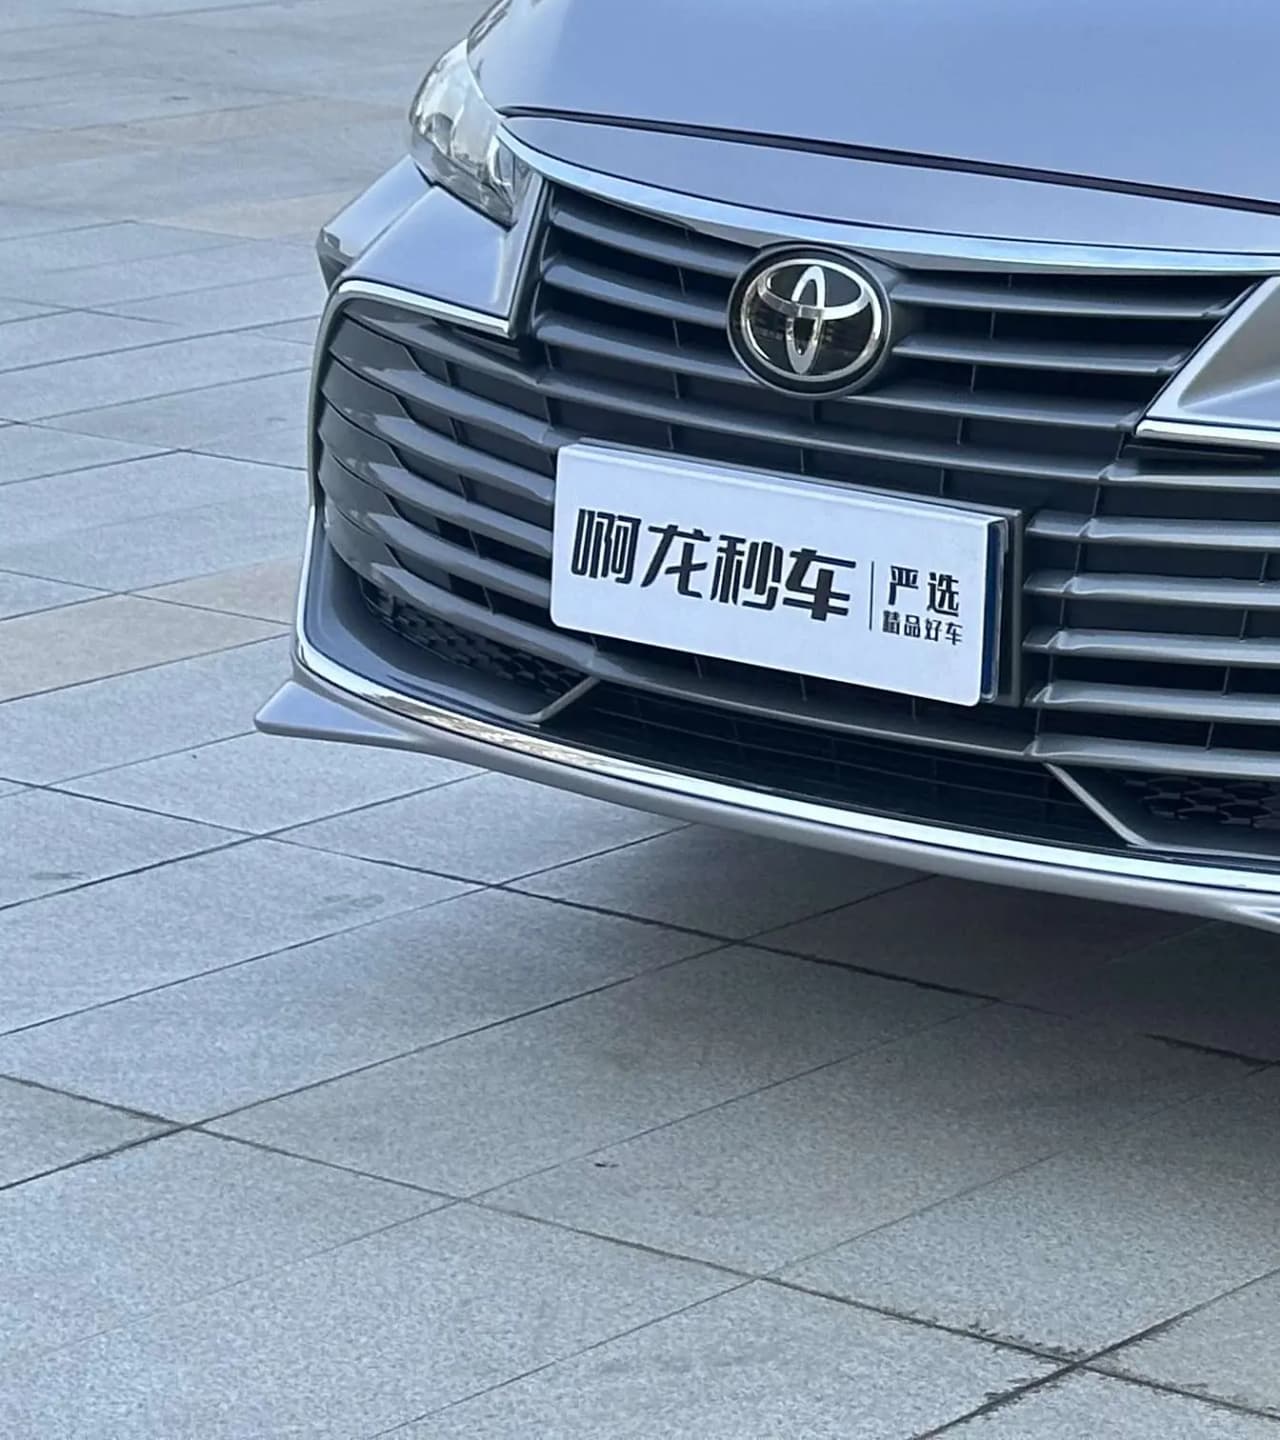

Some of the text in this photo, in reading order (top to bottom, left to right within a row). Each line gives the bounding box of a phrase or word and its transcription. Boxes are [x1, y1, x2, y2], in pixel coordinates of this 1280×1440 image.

[570, 508, 857, 622] 啊龙秒车
[888, 564, 961, 618] 严选
[882, 609, 964, 646] 精品好车
